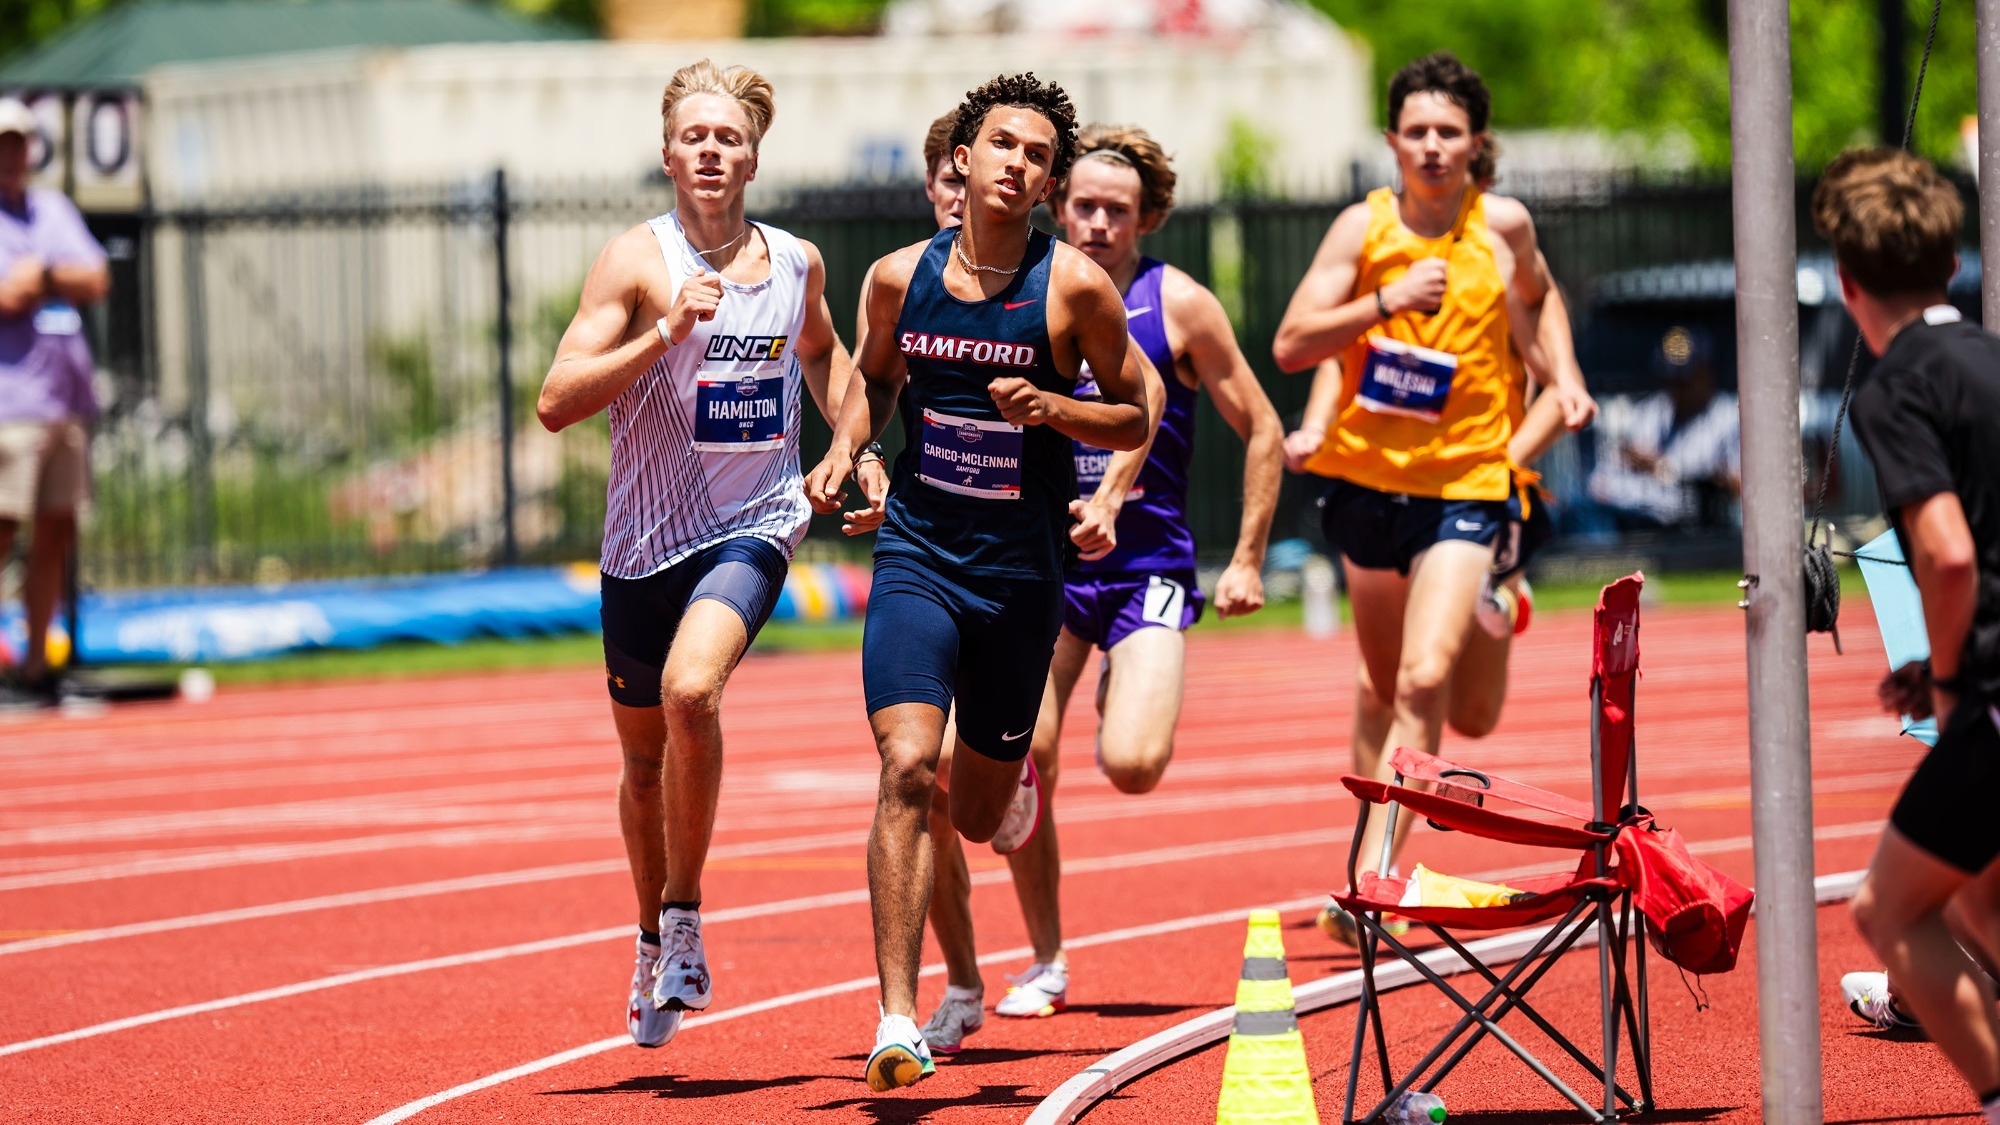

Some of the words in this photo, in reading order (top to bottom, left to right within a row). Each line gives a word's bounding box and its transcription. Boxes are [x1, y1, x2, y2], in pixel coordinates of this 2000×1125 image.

[704, 335, 788, 361] UNCG
[899, 332, 1036, 367] SAMFORD
[708, 398, 777, 420] HAMILTON
[924, 442, 1018, 469] CARICO-MCLENNAN
[955, 465, 981, 475] SAMFORD
[1159, 577, 1176, 618] 7
